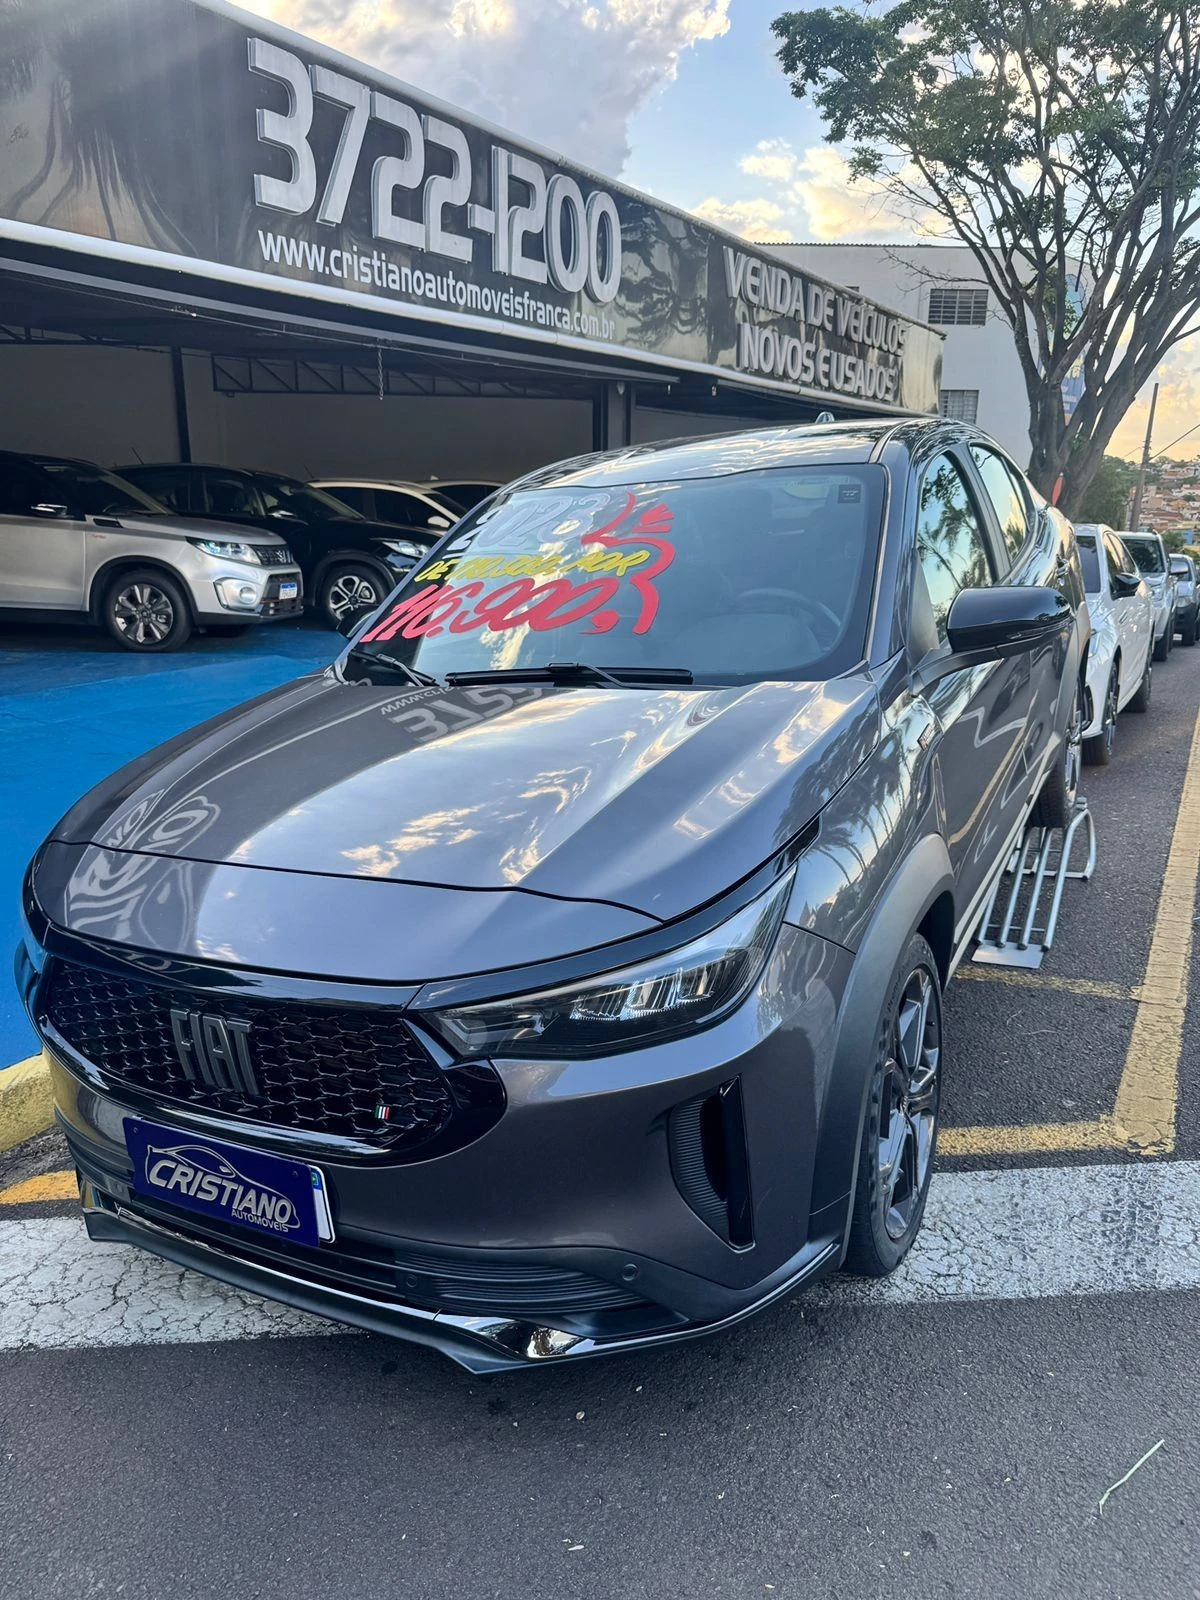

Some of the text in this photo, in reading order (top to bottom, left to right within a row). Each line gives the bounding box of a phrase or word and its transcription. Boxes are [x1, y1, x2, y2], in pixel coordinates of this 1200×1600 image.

[247, 37, 622, 303] 3722-1200
[258, 230, 615, 340] www.cristianoautomoveisfranca.com.br
[723, 246, 805, 322] VENDA
[807, 283, 835, 332] DE
[739, 323, 898, 402] NOVOS E USADOS
[414, 559, 460, 583] DE
[170, 1009, 260, 1096] FIAT
[149, 1160, 292, 1223] CRISTIANO
